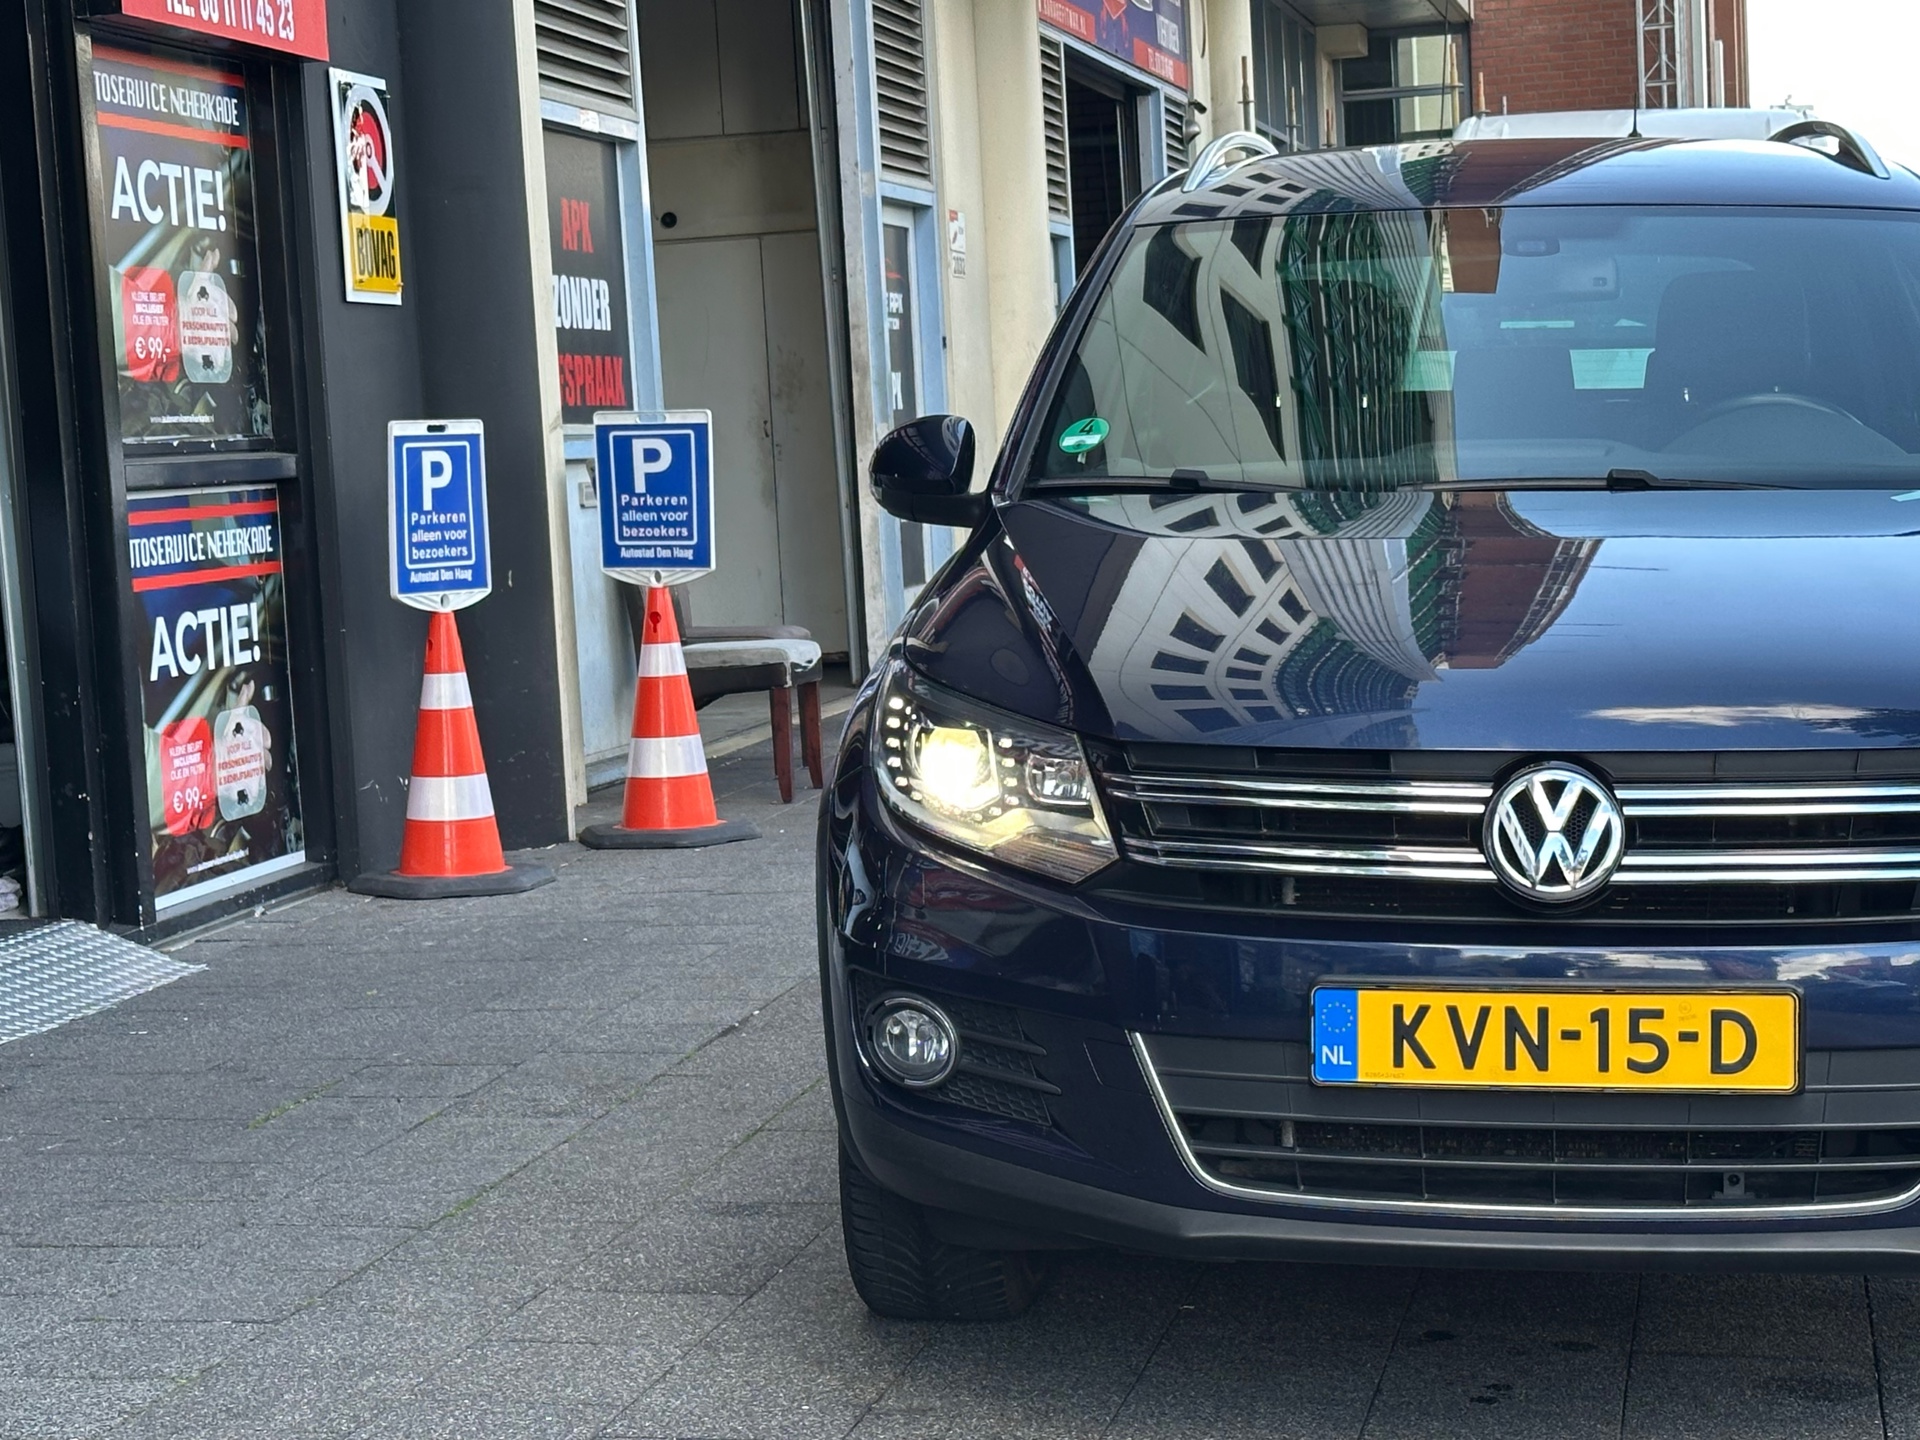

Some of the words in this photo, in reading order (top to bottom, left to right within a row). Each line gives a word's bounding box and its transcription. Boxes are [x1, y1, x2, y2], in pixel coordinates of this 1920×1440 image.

[277, 0, 295, 42] 23
[169, 86, 239, 126] NEHERKADE
[111, 156, 226, 232] ACTIE!
[561, 198, 593, 253] APK
[355, 227, 396, 280] BOVAG
[552, 274, 611, 331] ZONDER
[135, 336, 146, 359] €
[1079, 419, 1096, 435] 4
[632, 438, 673, 494] P
[421, 450, 453, 511] P
[621, 494, 688, 507] Parkeren
[411, 512, 467, 526] Parkeren
[622, 510, 658, 522] alleen
[660, 511, 689, 522] voor
[207, 525, 274, 560] NEHERKADE
[411, 529, 442, 542] alleen
[443, 529, 467, 541] voor
[623, 525, 689, 537] bezoekers
[412, 545, 469, 560] bezoekers
[620, 547, 655, 559] Autostad
[656, 547, 672, 559] Den
[673, 547, 694, 561] Haag
[410, 569, 440, 583] Autostad
[440, 568, 454, 581] Den
[455, 567, 473, 581] Haag
[149, 602, 261, 681] ACTIE!
[173, 790, 184, 813] €
[1391, 1003, 1758, 1076] KVN-15-D
[1322, 1045, 1352, 1066] NL
